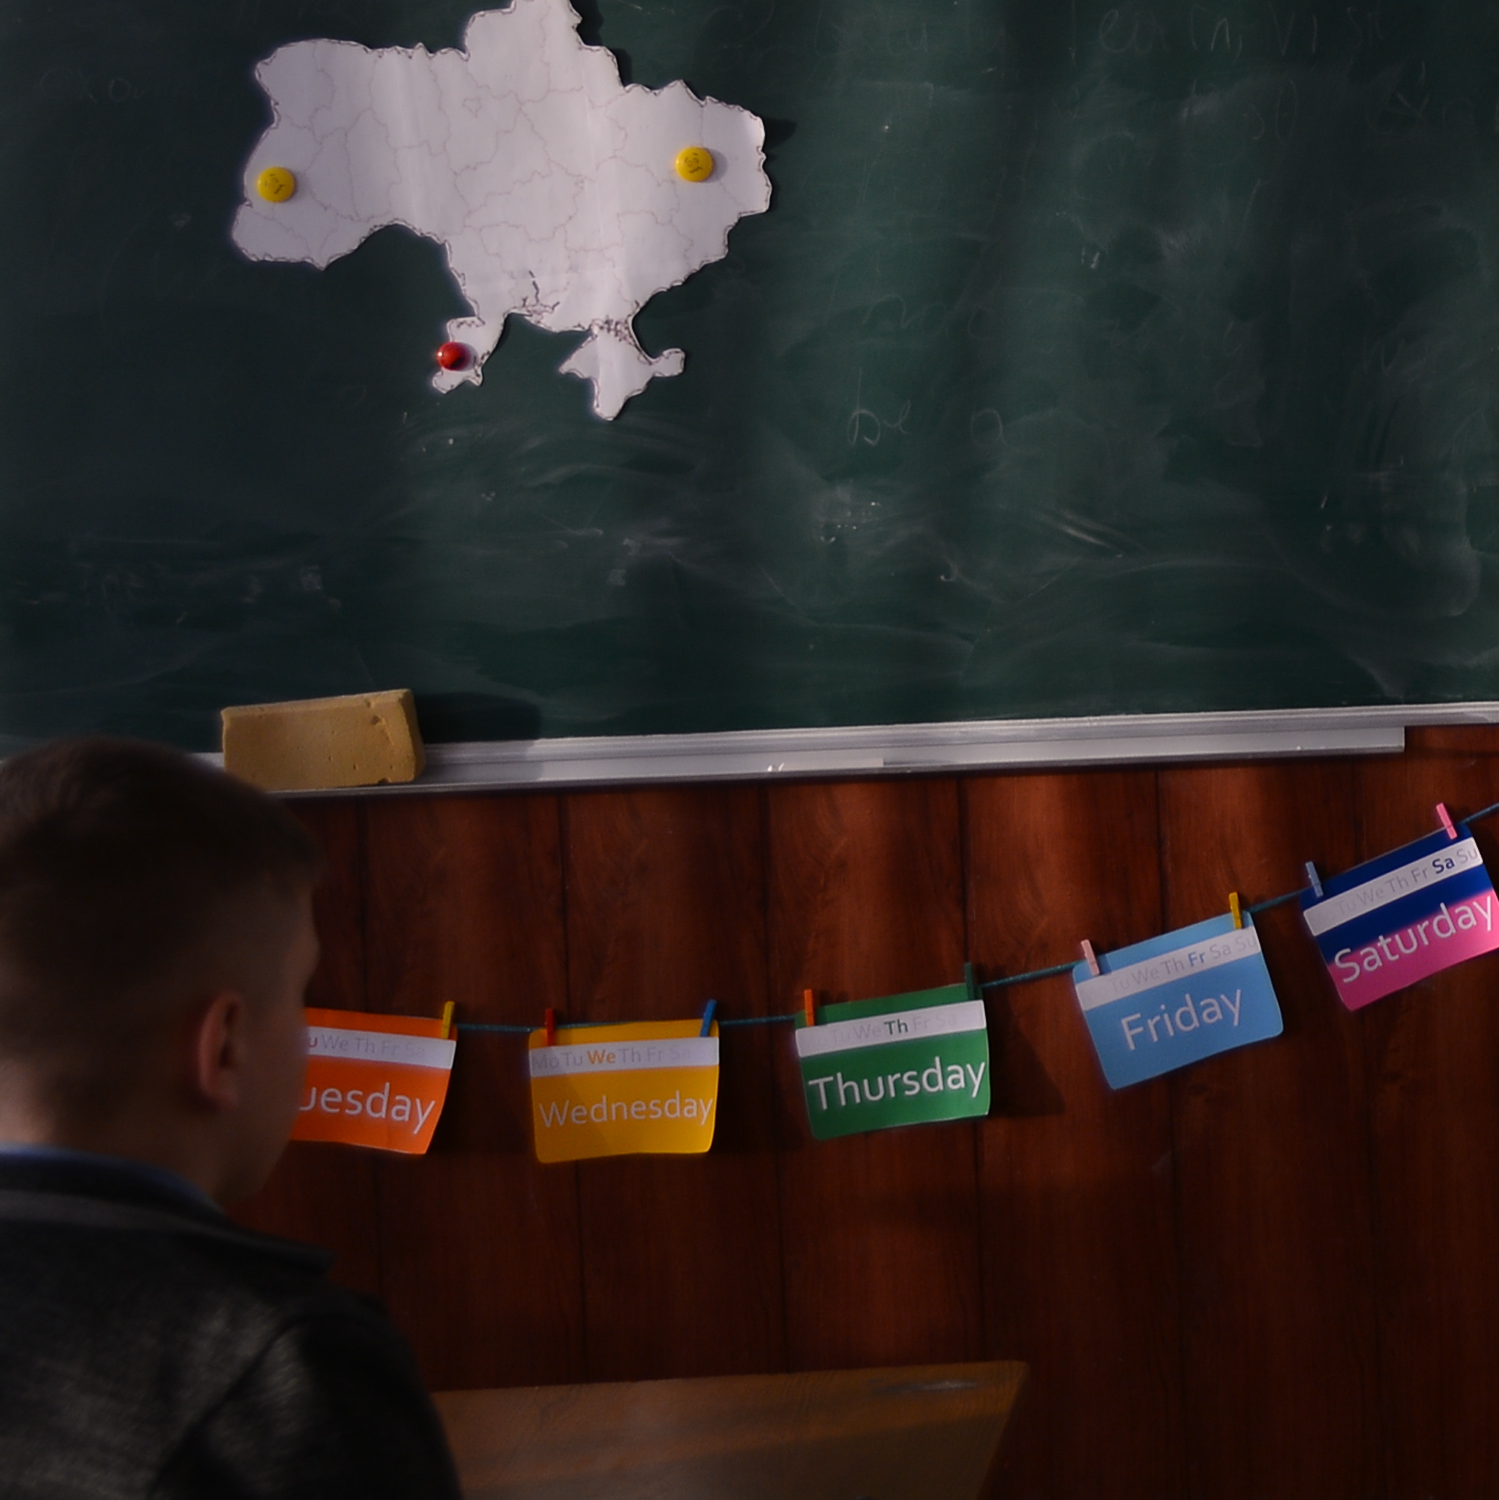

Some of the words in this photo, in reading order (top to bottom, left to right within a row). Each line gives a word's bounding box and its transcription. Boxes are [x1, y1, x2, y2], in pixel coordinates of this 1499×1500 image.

[1432, 857, 1456, 875] Sa
[1333, 895, 1492, 984] Saturday
[1187, 951, 1206, 968] Fr
[884, 1018, 909, 1036] Th
[1120, 988, 1242, 1051] Friday
[587, 1049, 617, 1065] We
[808, 1055, 986, 1111] Thursday
[300, 1081, 436, 1135] uesday
[539, 1090, 714, 1128] Wednesday
